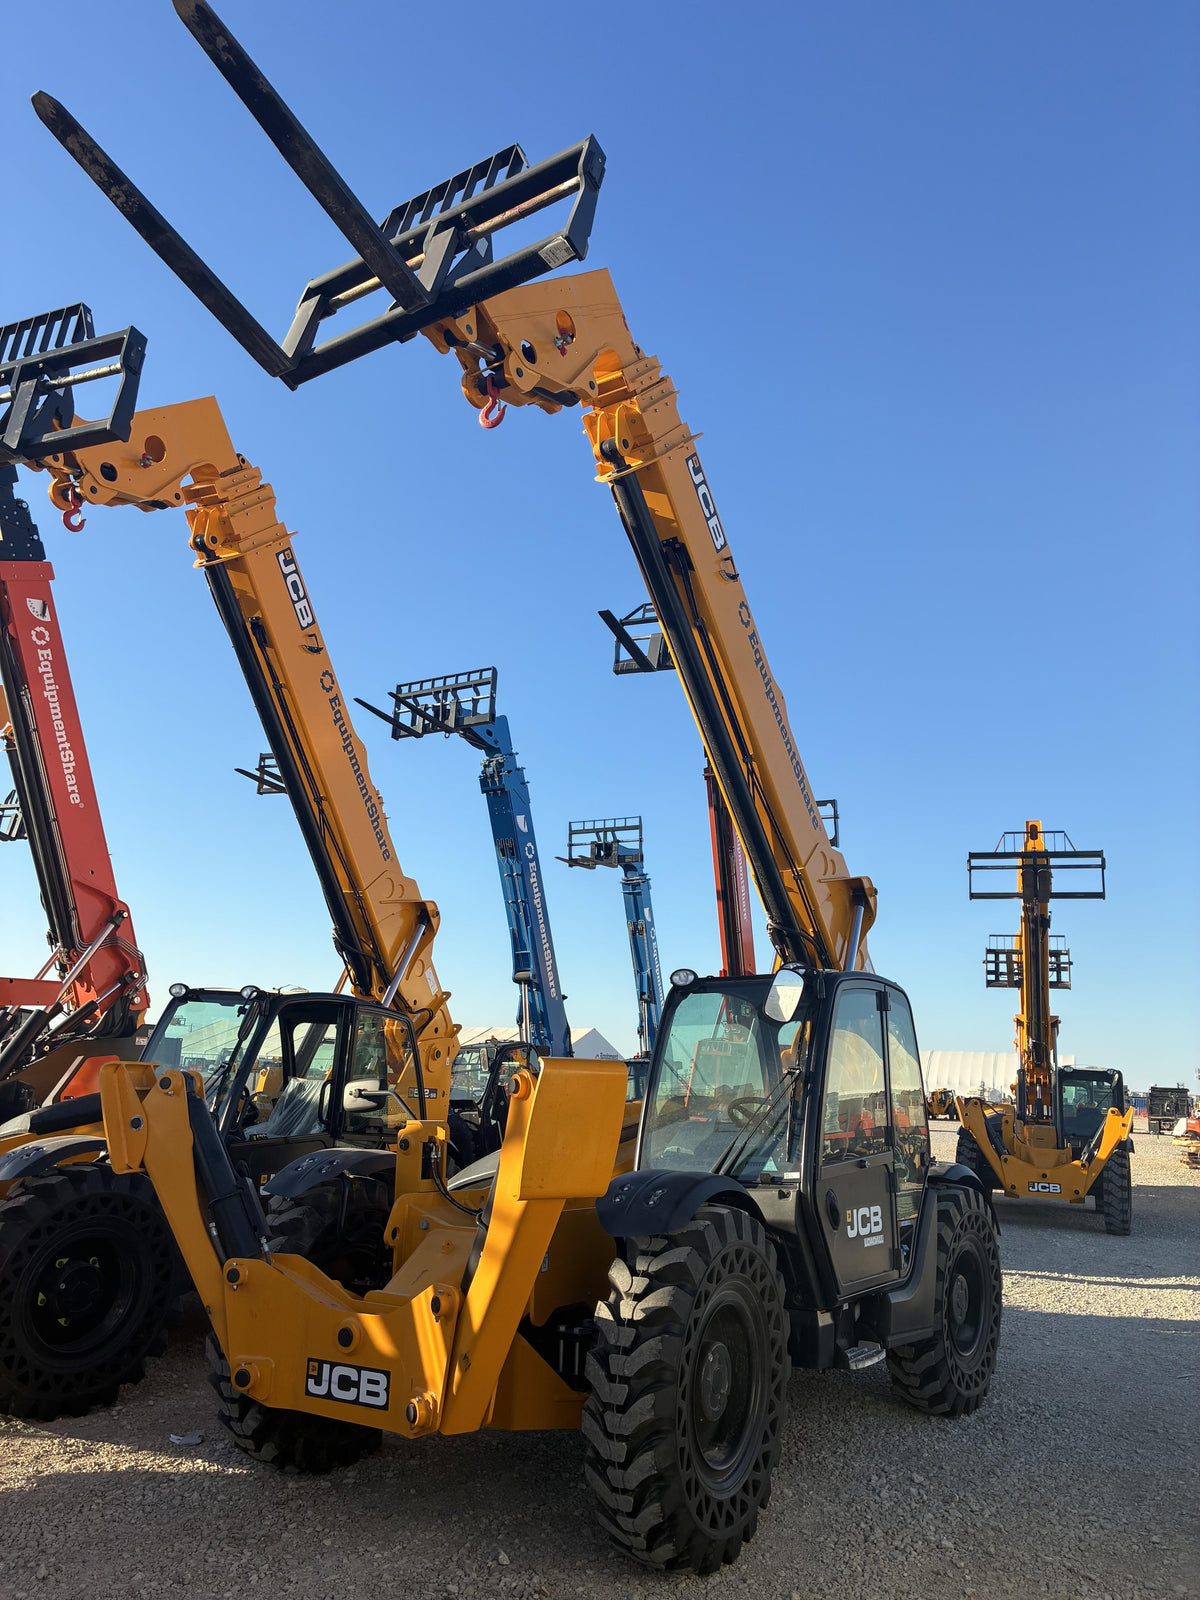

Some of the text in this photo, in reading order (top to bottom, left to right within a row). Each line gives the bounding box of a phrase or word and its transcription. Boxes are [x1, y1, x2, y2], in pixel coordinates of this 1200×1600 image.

[688, 458, 725, 550] JCB
[278, 552, 313, 628] JCB
[37, 648, 80, 804] EquipmentShare
[748, 629, 819, 831] EquipmentShare
[329, 693, 391, 861] EquipmentShare
[528, 862, 557, 998] EquipmentShare
[847, 1205, 883, 1238] JCB
[1029, 1182, 1061, 1193] JCB
[307, 1363, 387, 1406] JCB
